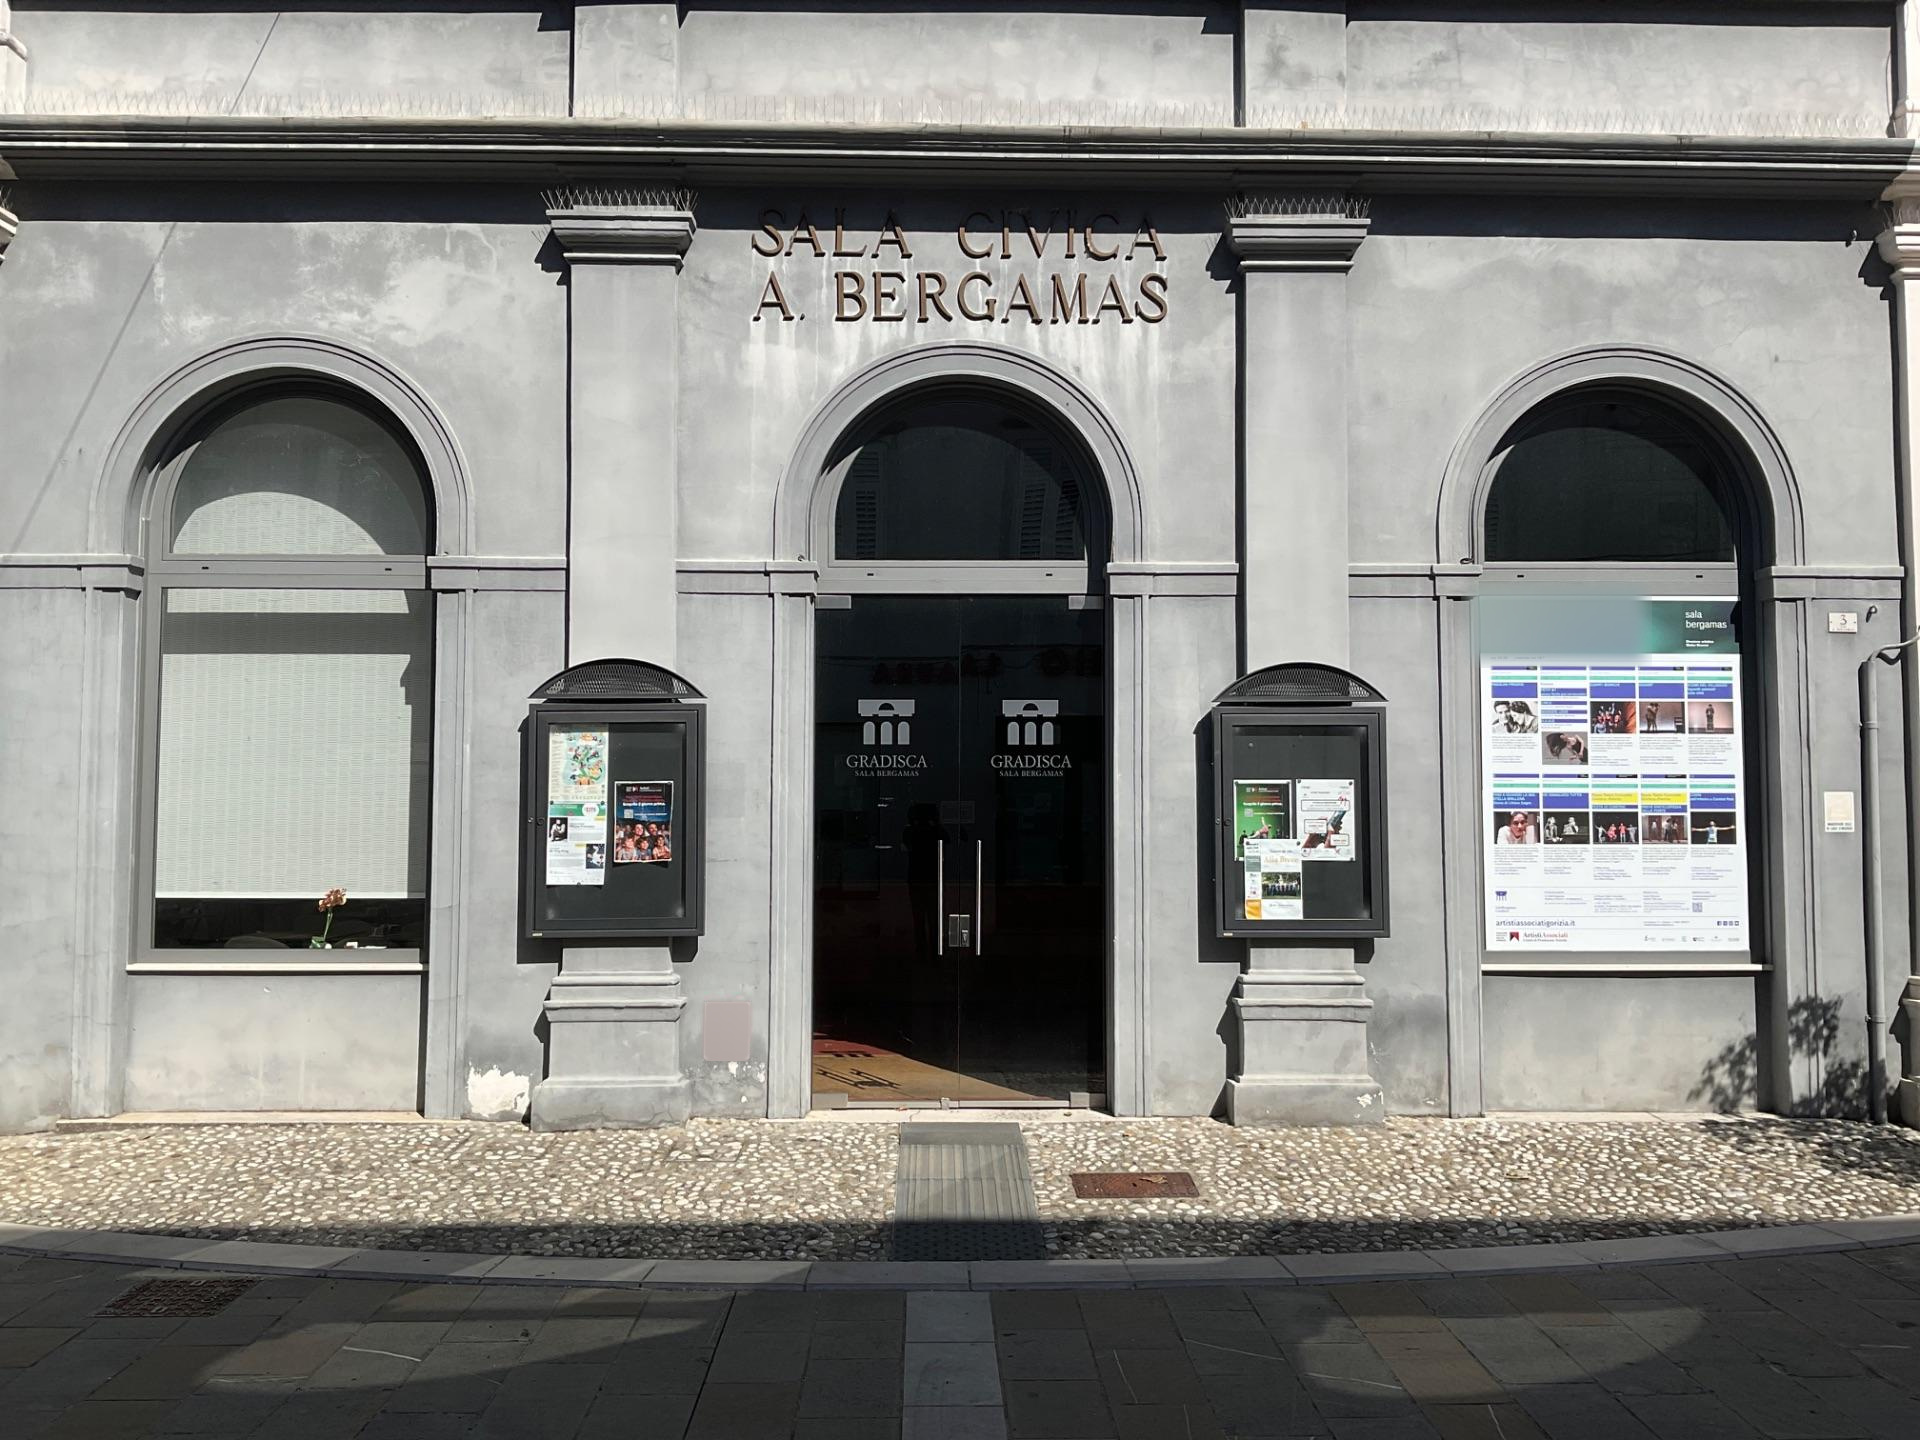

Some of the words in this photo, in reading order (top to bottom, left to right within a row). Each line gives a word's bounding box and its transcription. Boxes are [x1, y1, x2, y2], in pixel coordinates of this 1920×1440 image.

[751, 208, 914, 258] SALA
[957, 208, 1168, 261] CIVICA
[752, 271, 805, 322] A.
[834, 271, 1169, 324] BERGAMAS
[1685, 610, 1703, 618] sala
[1840, 614, 1848, 625] 3
[1685, 620, 1728, 630] bergamas
[846, 754, 928, 769] GRADISCA
[990, 754, 1072, 769] GRADISCA
[1496, 919, 1576, 928] artistiassociatigorizia.it
